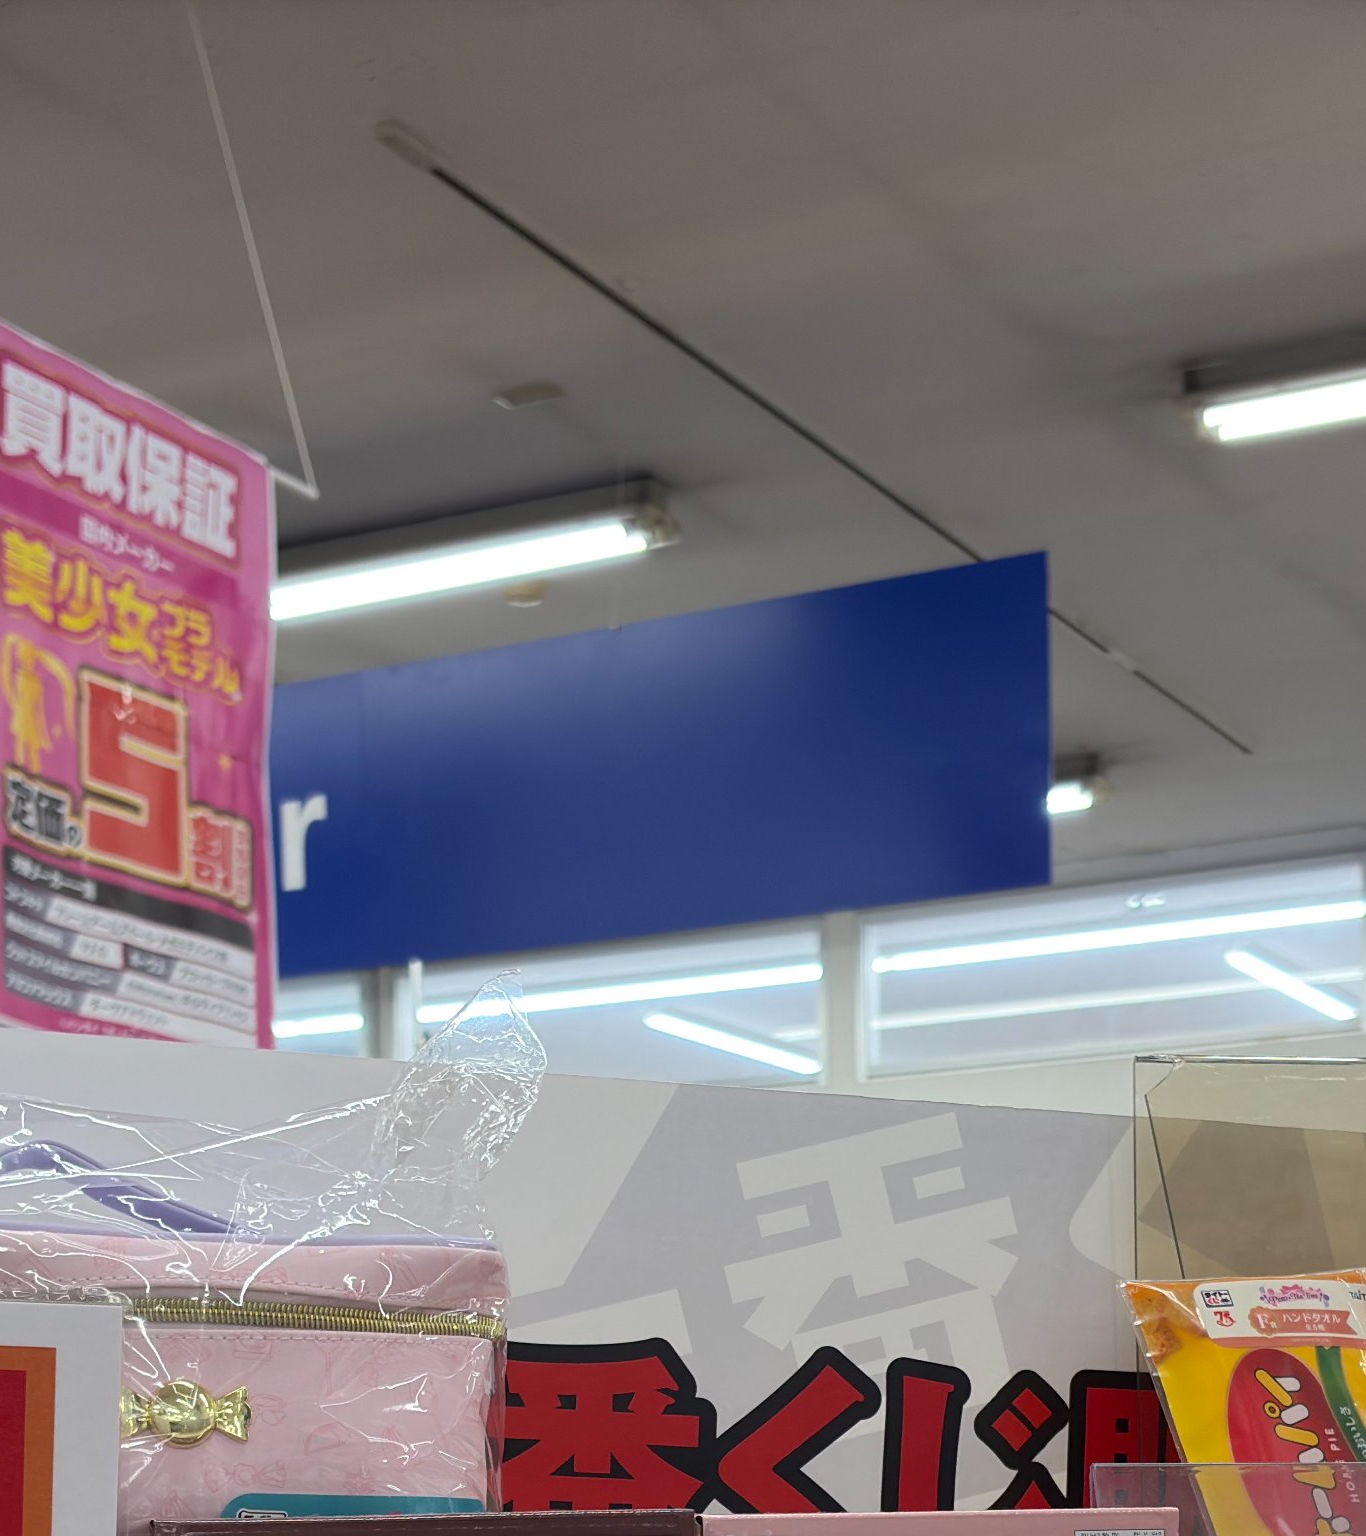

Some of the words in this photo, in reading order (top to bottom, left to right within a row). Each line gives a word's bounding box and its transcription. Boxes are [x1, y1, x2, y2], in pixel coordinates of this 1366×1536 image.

[1, 360, 238, 557] 買取保証
[2, 526, 159, 664] 美少女
[161, 603, 211, 646] プラ
[84, 676, 186, 882] 5
[1282, 1313, 1342, 1324] ハンドタオル
